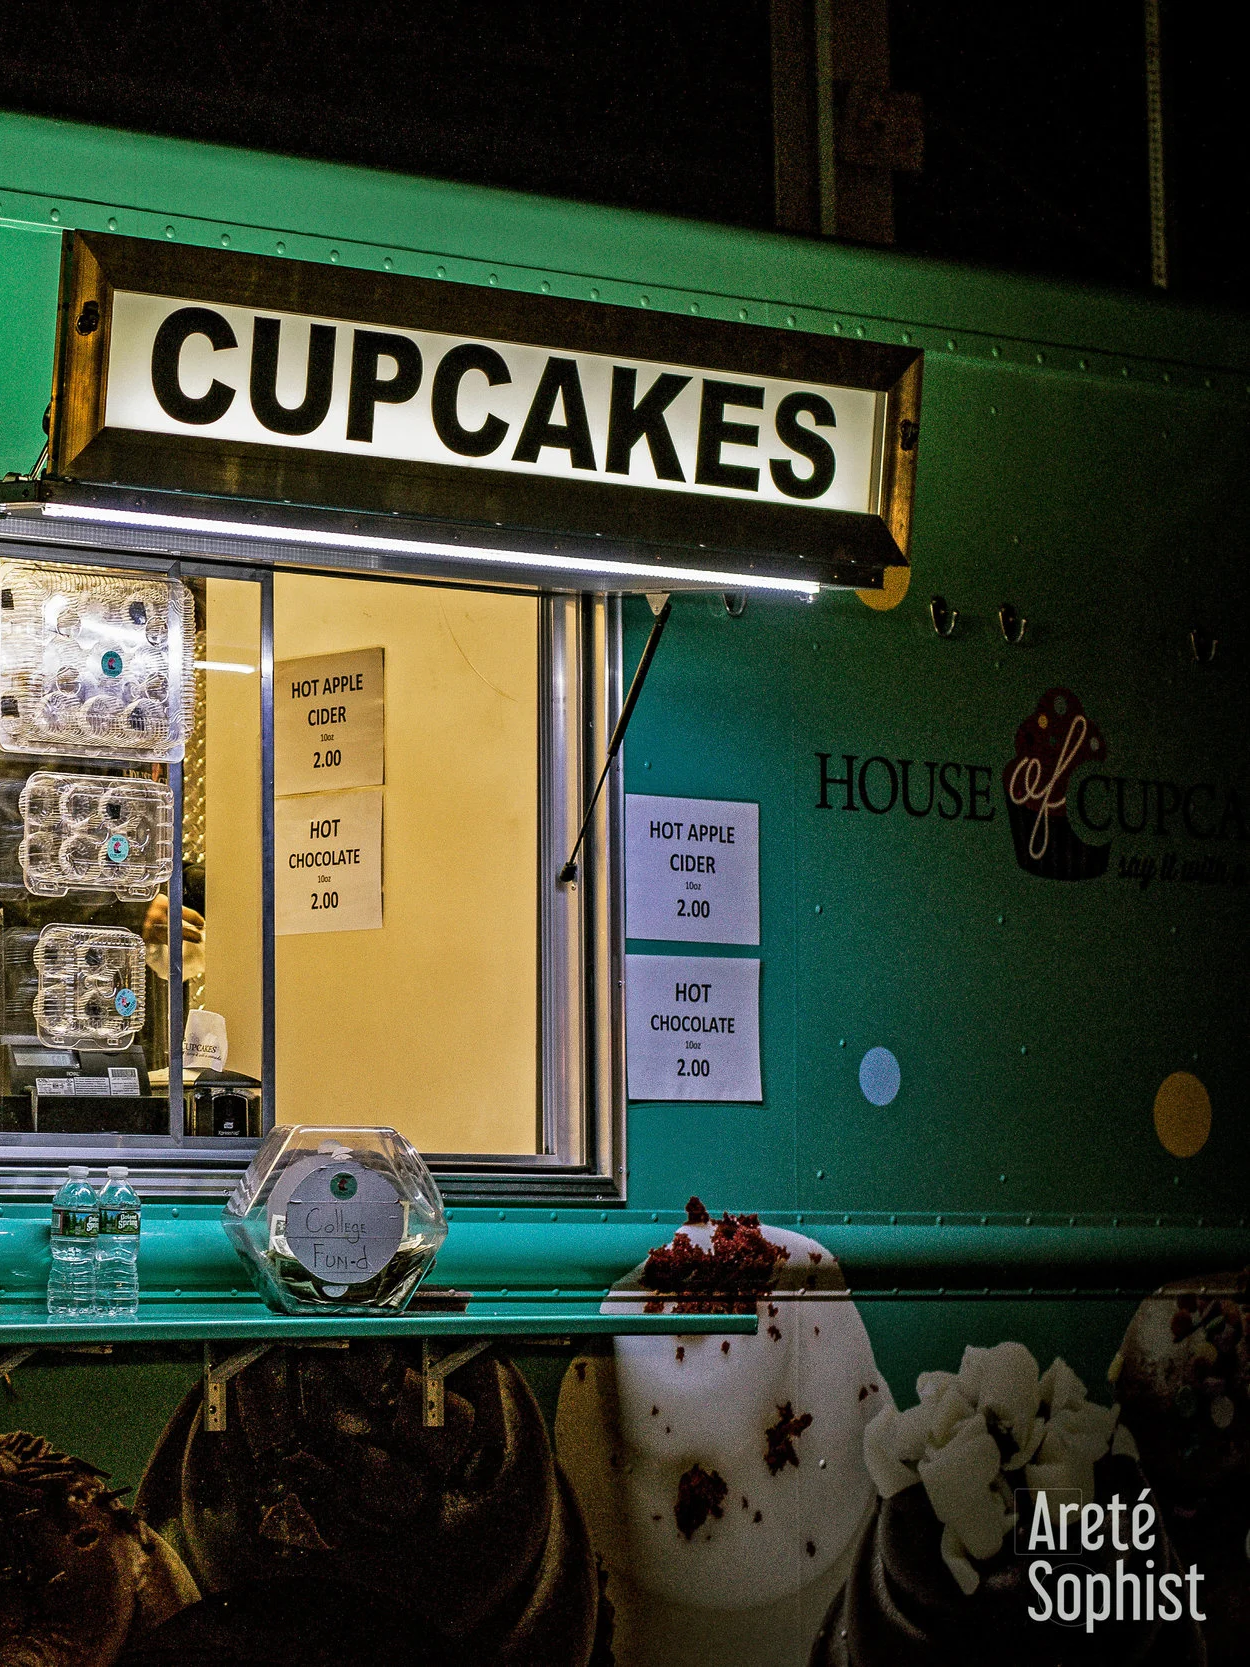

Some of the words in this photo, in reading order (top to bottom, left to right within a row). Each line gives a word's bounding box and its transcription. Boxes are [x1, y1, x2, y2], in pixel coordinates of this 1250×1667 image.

[150, 306, 838, 500] CUPCAKES
[291, 679, 319, 699] HOT
[322, 673, 363, 694] APPLE
[308, 706, 347, 726] CIDER
[313, 750, 342, 768] 2.00
[815, 753, 995, 821] HOUSE
[1010, 715, 1088, 858] of
[310, 819, 340, 839] HOT
[650, 820, 683, 840] HOT
[688, 824, 735, 844] APPLE
[289, 849, 361, 868] CHOCOLATE
[670, 853, 716, 874] CIDER
[311, 891, 339, 910] 2.00
[677, 899, 710, 918] 2.00
[675, 982, 712, 1002] HOT
[650, 1014, 735, 1034] CHOCOLATE
[677, 1058, 710, 1077] 2.00
